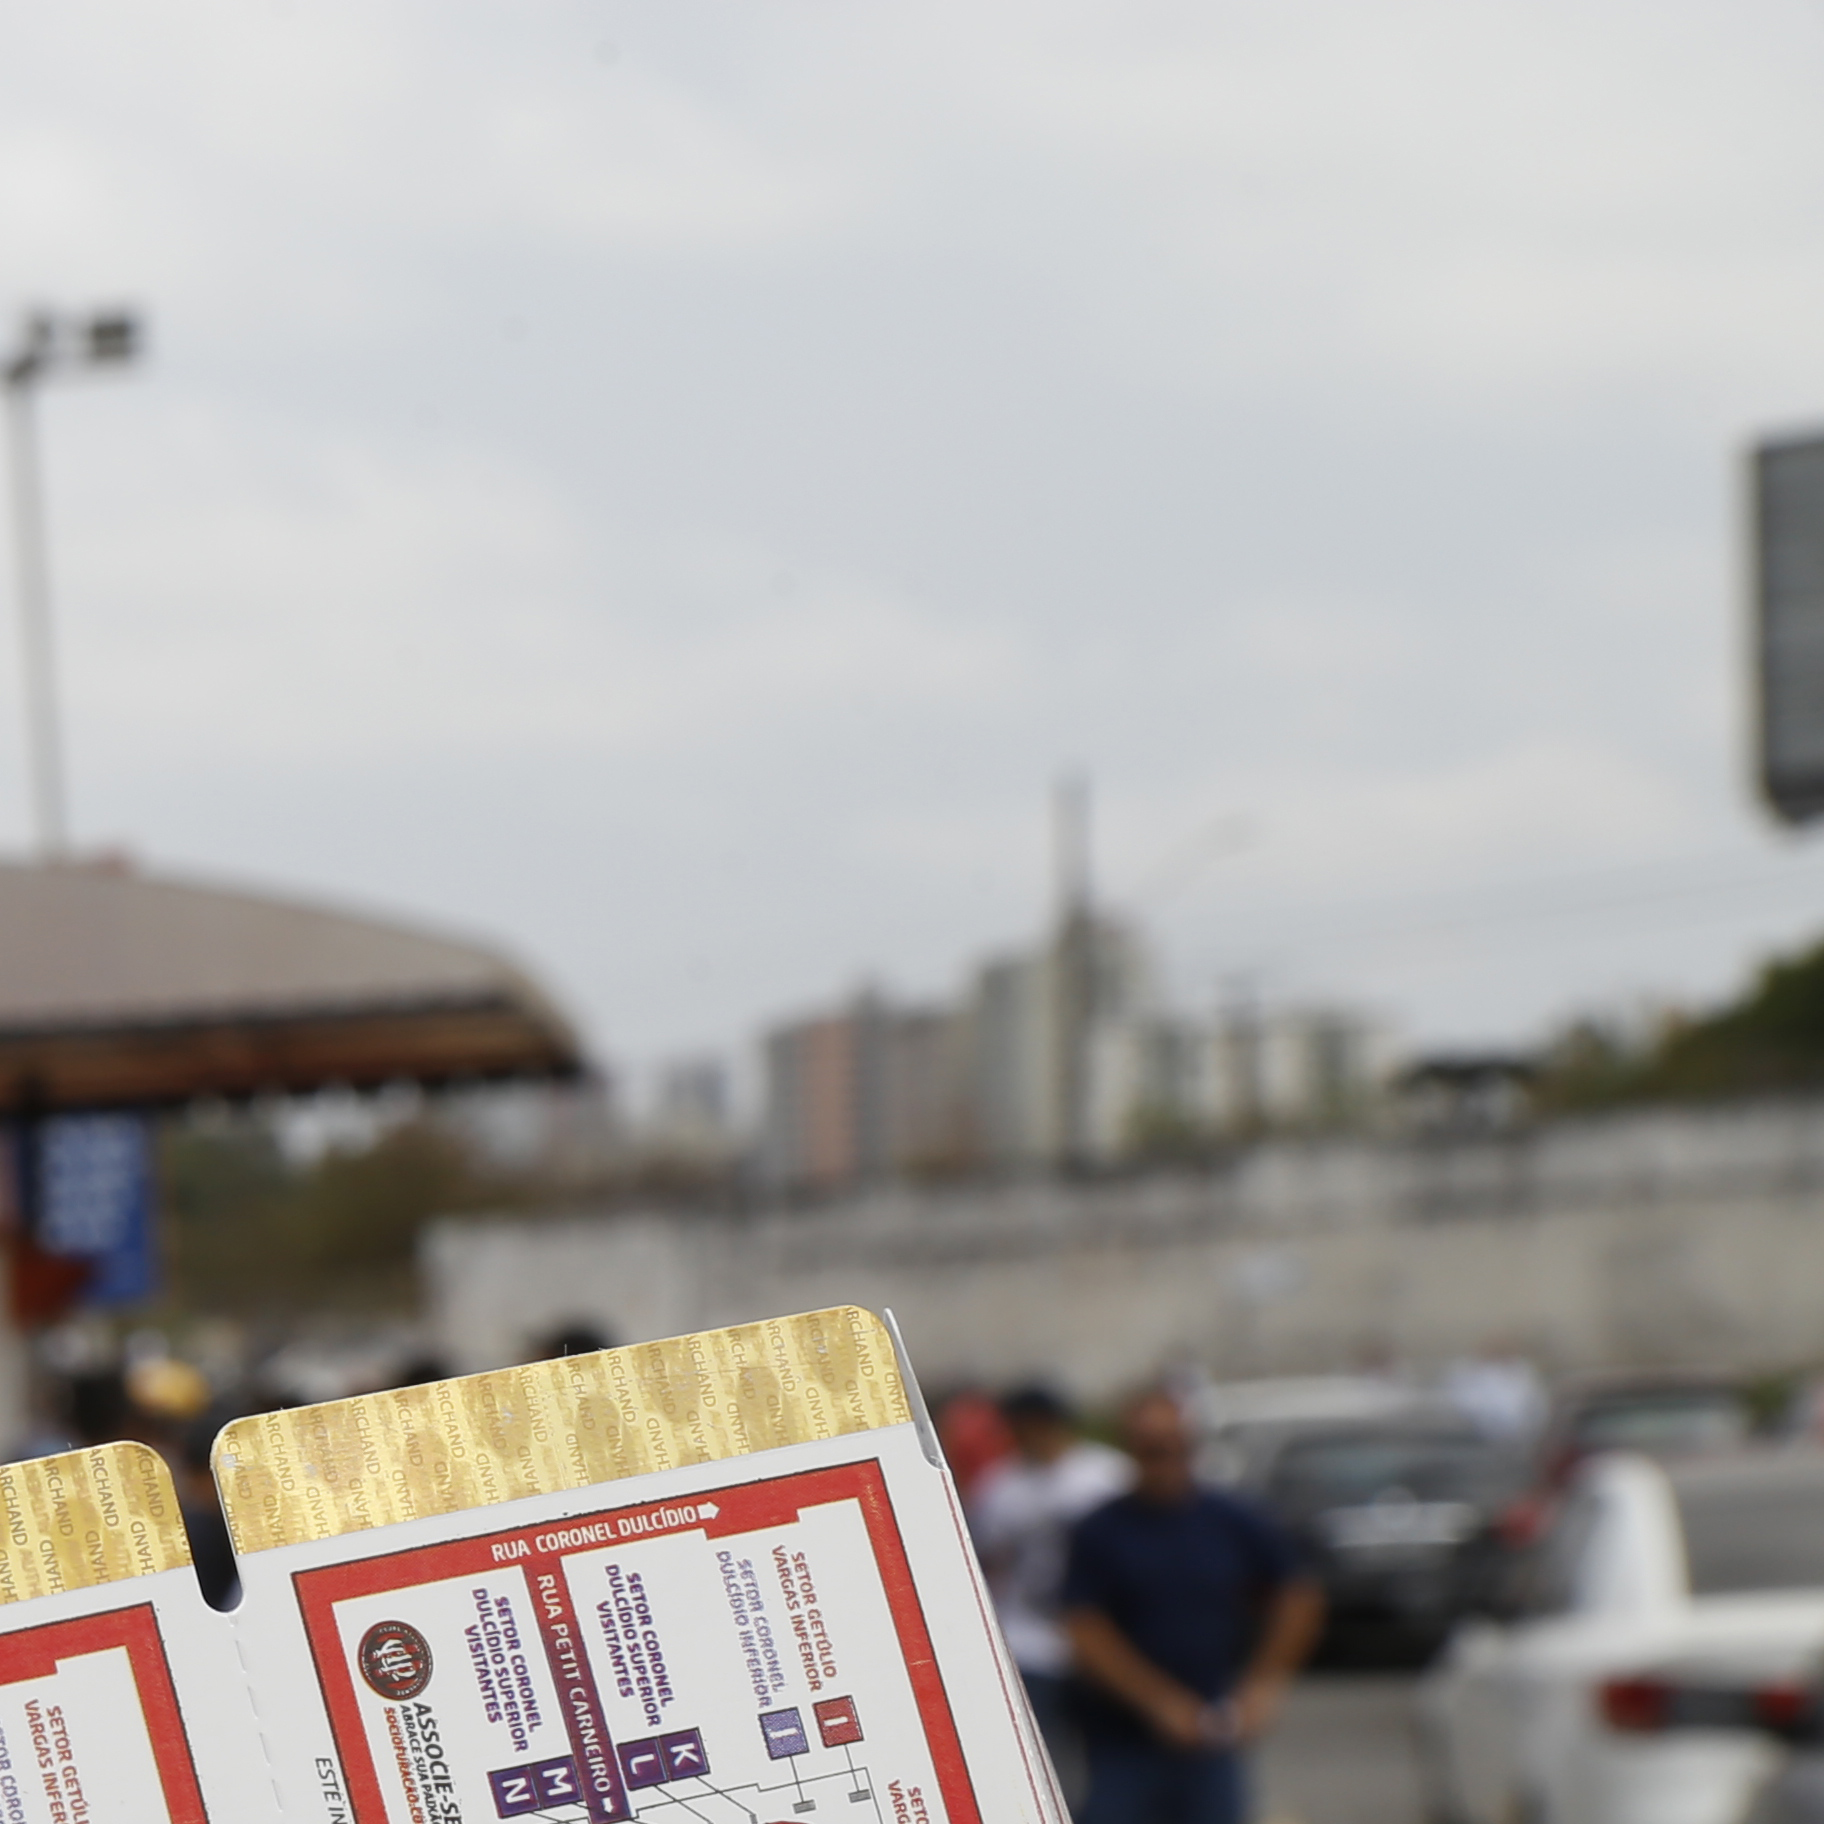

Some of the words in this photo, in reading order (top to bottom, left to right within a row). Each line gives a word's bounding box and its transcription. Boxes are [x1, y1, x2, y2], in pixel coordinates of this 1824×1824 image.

[490, 1538, 531, 1561] RUA
[533, 1521, 616, 1554] CORONEL
[614, 1500, 698, 1537] DULCÍDIO
[535, 1573, 565, 1621] RUA
[604, 1563, 640, 1641] DULCÍDIO
[626, 1642, 661, 1726] SUPERIOR
[625, 1572, 652, 1628] SETOR
[641, 1629, 674, 1707] CORONEL
[549, 1622, 583, 1684] PETIT
[595, 1600, 634, 1698] VISITANTES
[567, 1685, 613, 1793] CARNEIRO
